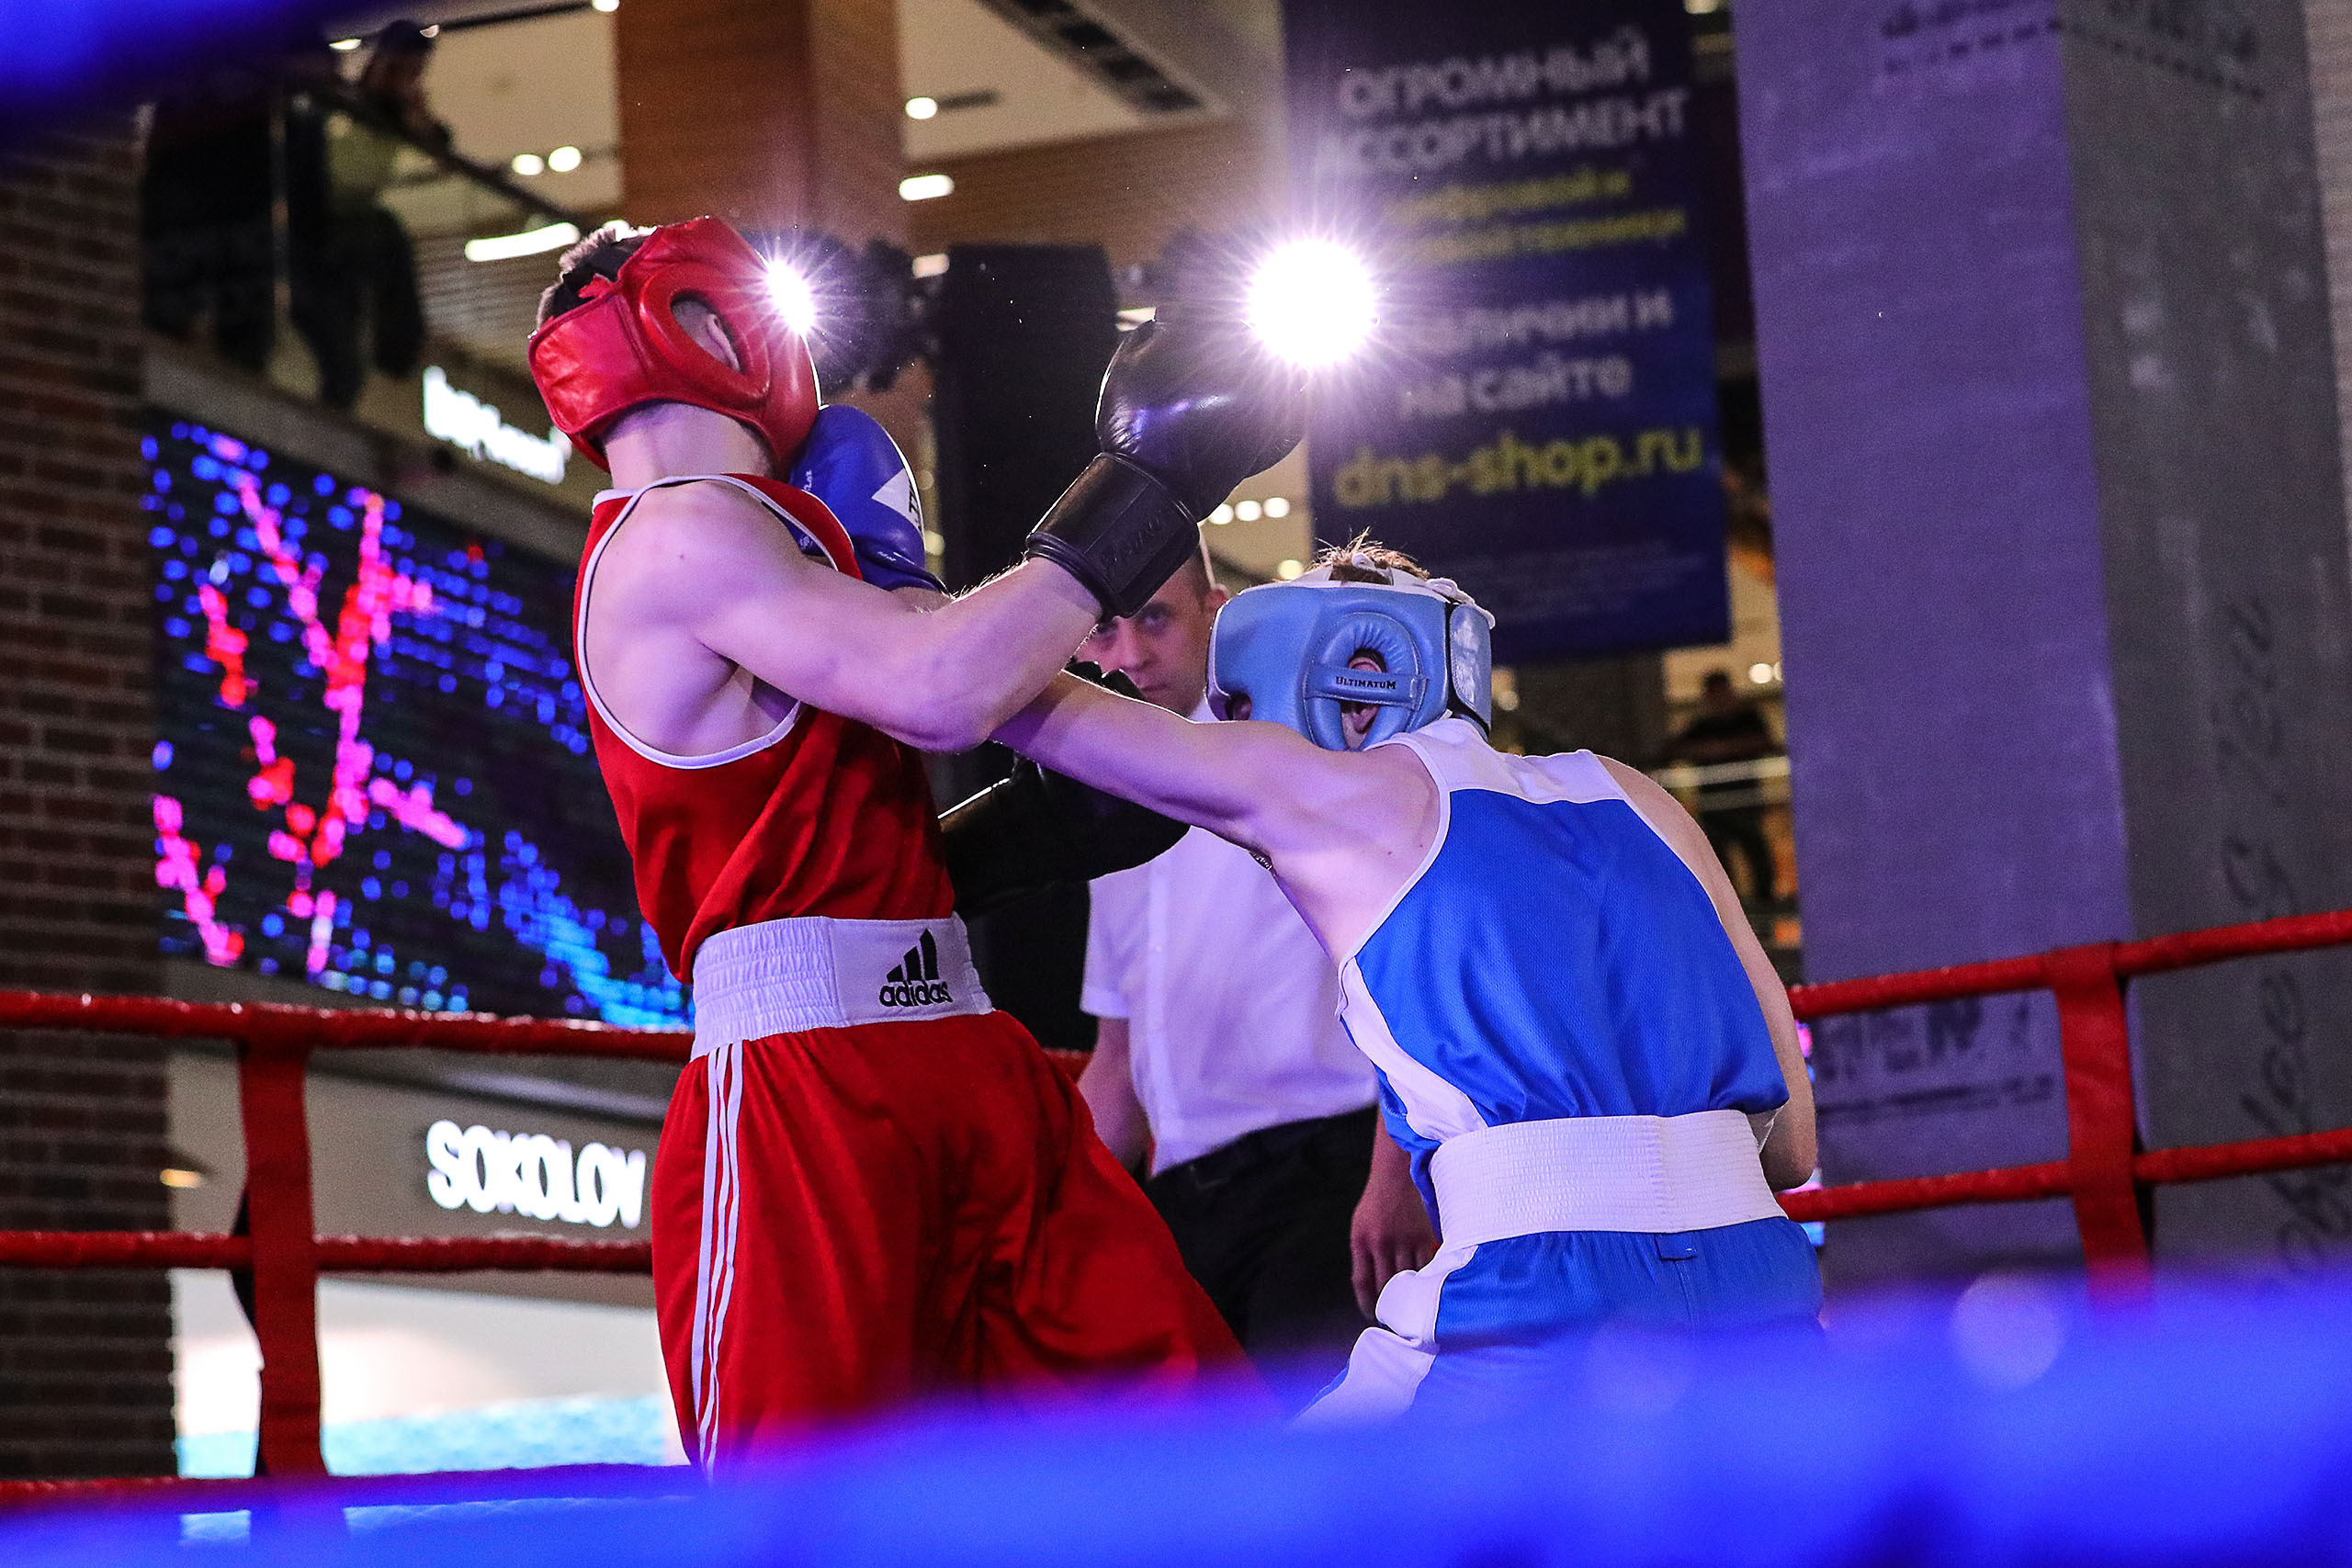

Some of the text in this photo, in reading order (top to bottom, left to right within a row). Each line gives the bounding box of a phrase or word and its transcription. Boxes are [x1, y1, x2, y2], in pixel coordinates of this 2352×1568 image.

[1338, 25, 1651, 118] ОГРОМНЫЙ
[1470, 353, 1633, 412] сайте
[1334, 427, 1703, 508] dns-shop.ru
[1336, 676, 1396, 690] ULTIMATUM
[879, 979, 954, 1008] adidas
[425, 1120, 647, 1229] SOKOLOV
